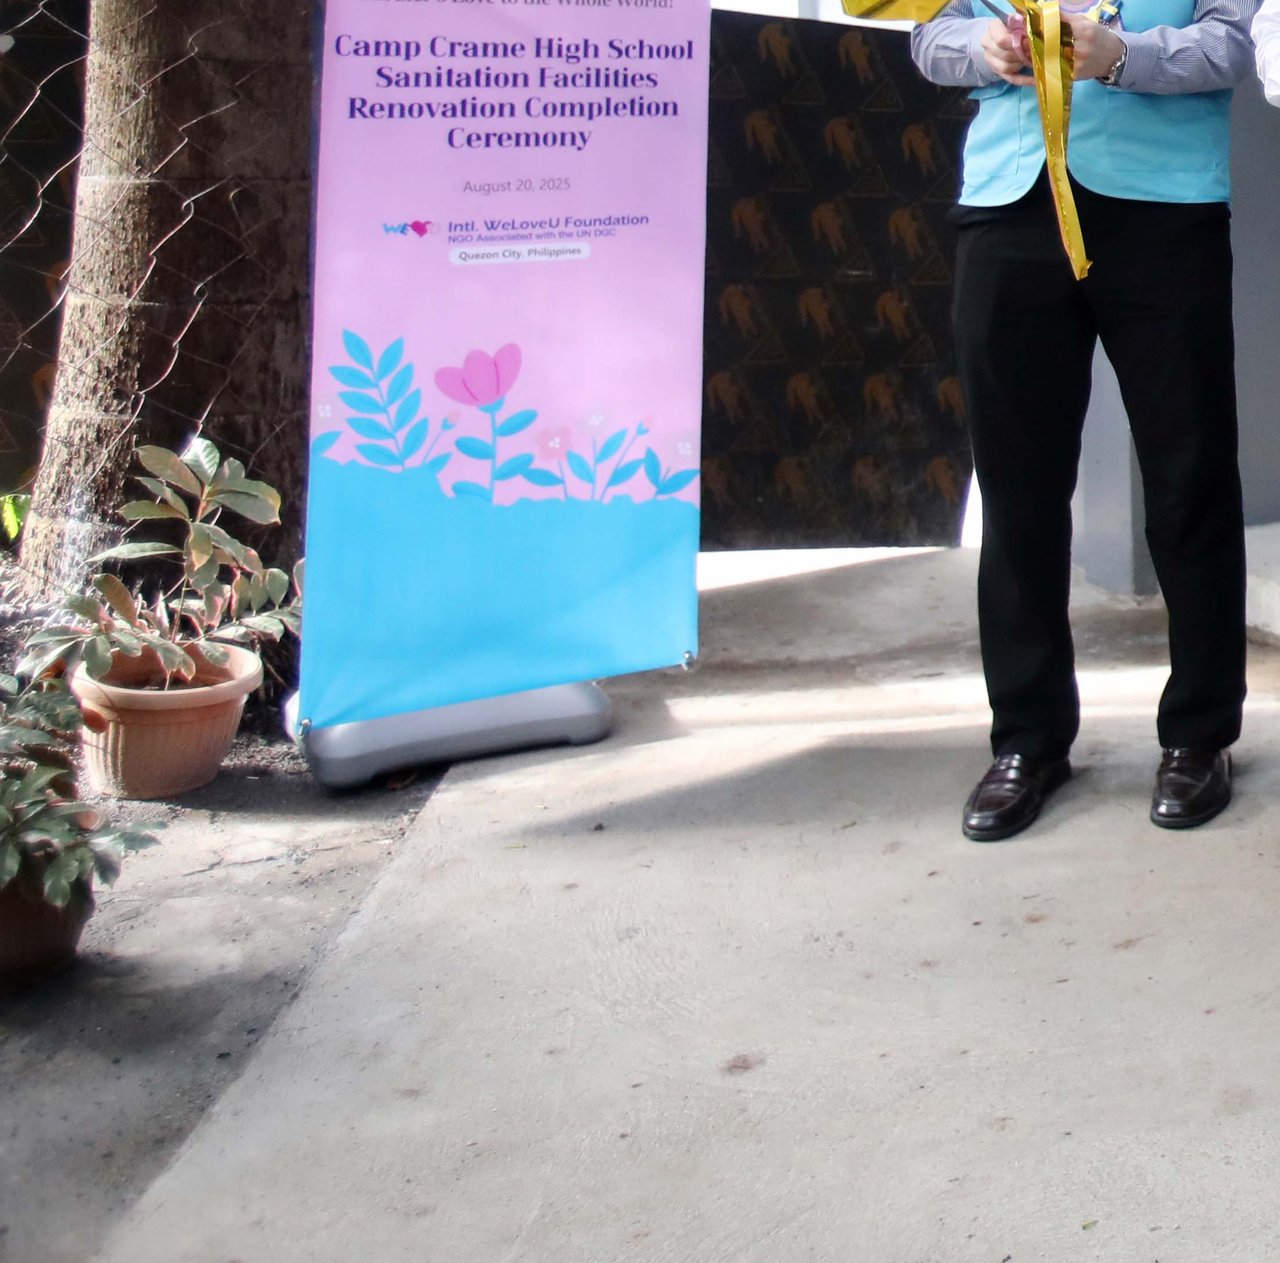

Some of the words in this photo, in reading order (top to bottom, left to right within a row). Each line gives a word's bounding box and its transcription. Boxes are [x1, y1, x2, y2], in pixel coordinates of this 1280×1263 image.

[335, 34, 421, 61] Camp
[430, 36, 526, 58] Crame
[534, 37, 600, 64] High
[608, 38, 694, 59] School
[376, 66, 529, 88] Sanitation
[539, 67, 659, 88] Facilities
[348, 96, 516, 119] Renovation
[525, 96, 679, 121] Completion
[447, 127, 592, 151] Ceremony
[463, 180, 511, 196] August
[515, 178, 535, 193] 20,
[539, 176, 571, 191] 2025
[448, 221, 479, 233] Intl.
[484, 217, 560, 232] WeLoveU
[565, 214, 649, 228] Foundation
[448, 235, 474, 244] NGO
[477, 232, 533, 243] Associated
[535, 231, 556, 239] with
[558, 230, 575, 238] the
[459, 250, 500, 262] Quezon
[502, 248, 525, 260] City,
[527, 246, 582, 258] Philippines
